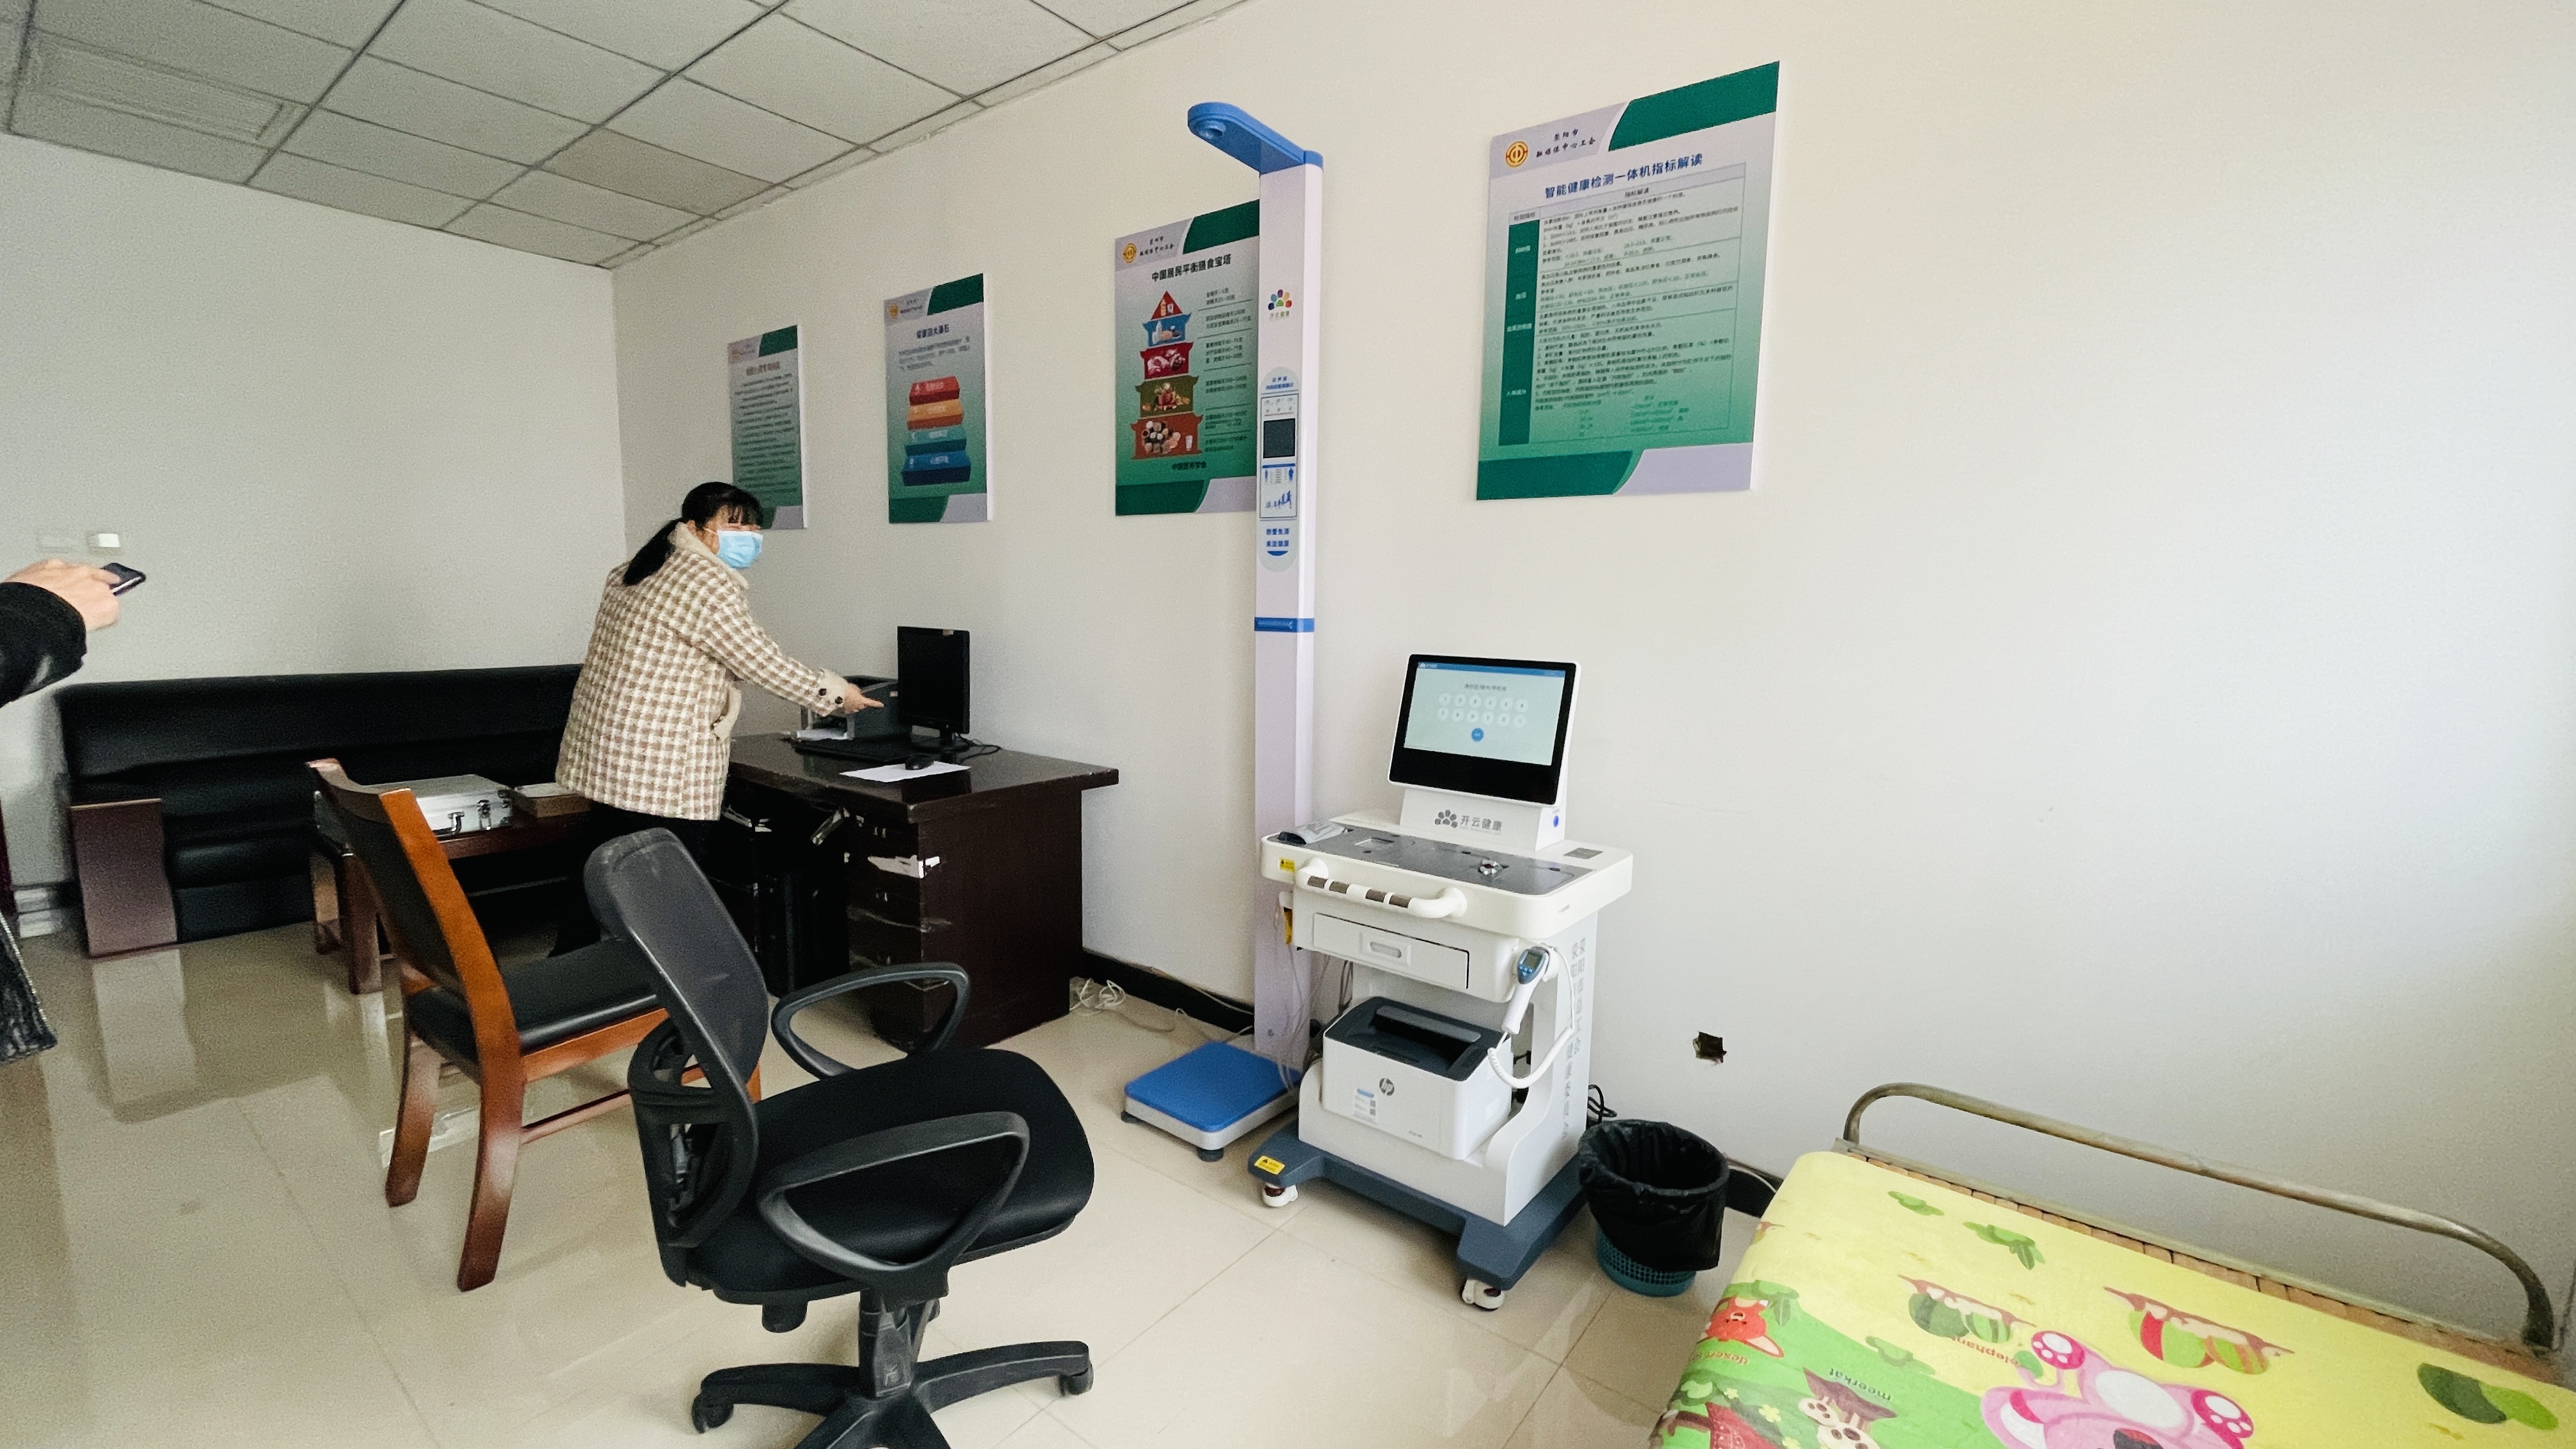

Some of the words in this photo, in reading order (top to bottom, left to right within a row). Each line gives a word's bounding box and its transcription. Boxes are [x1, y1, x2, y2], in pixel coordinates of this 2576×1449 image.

[1545, 153, 1703, 199] 智能健康检测一体机指标解读
[1460, 815, 1503, 831] 开云健康
[1379, 1078, 1395, 1096] hp
[1829, 1368, 1891, 1400] meerkat
